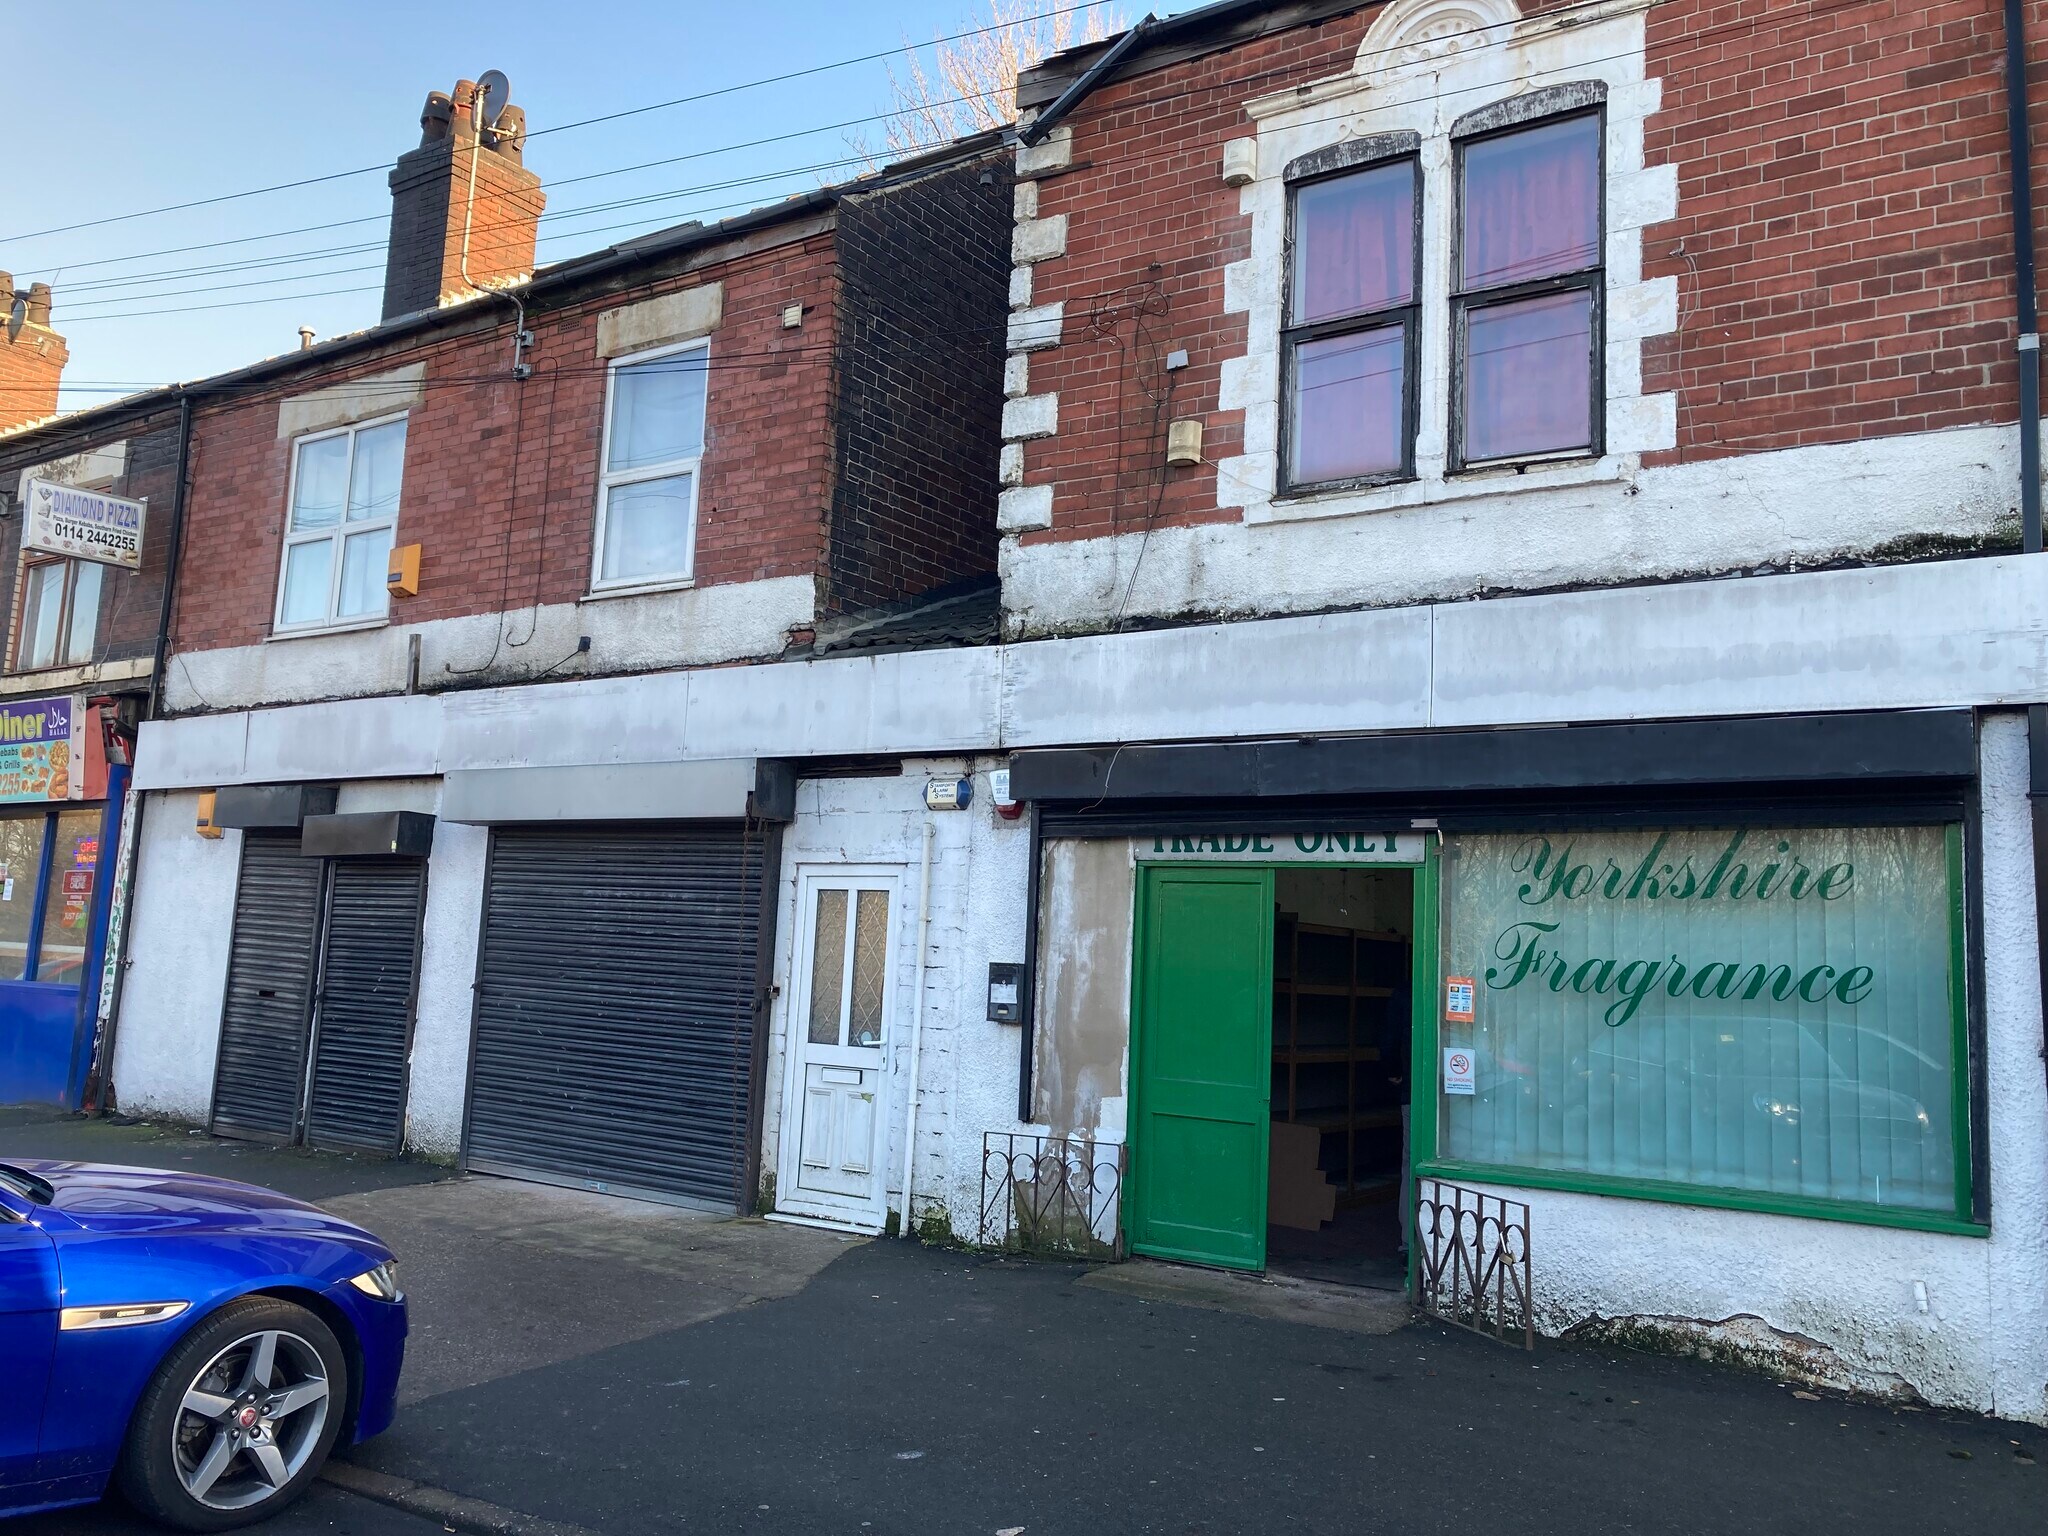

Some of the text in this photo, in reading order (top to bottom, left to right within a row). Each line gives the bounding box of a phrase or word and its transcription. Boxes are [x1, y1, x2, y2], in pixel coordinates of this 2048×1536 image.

[53, 490, 139, 530] DIAMOND PIZZA
[55, 522, 135, 551] 0114 2442255
[122, 529, 137, 537] Chicken
[49, 727, 67, 736] HALAL
[0, 747, 18, 757] ebabs
[4, 760, 20, 769] Grills
[80, 842, 98, 853] OPE
[76, 853, 97, 863] Welco
[1510, 830, 1855, 906] Yorkshire
[1485, 921, 1874, 1028] Fragrance
